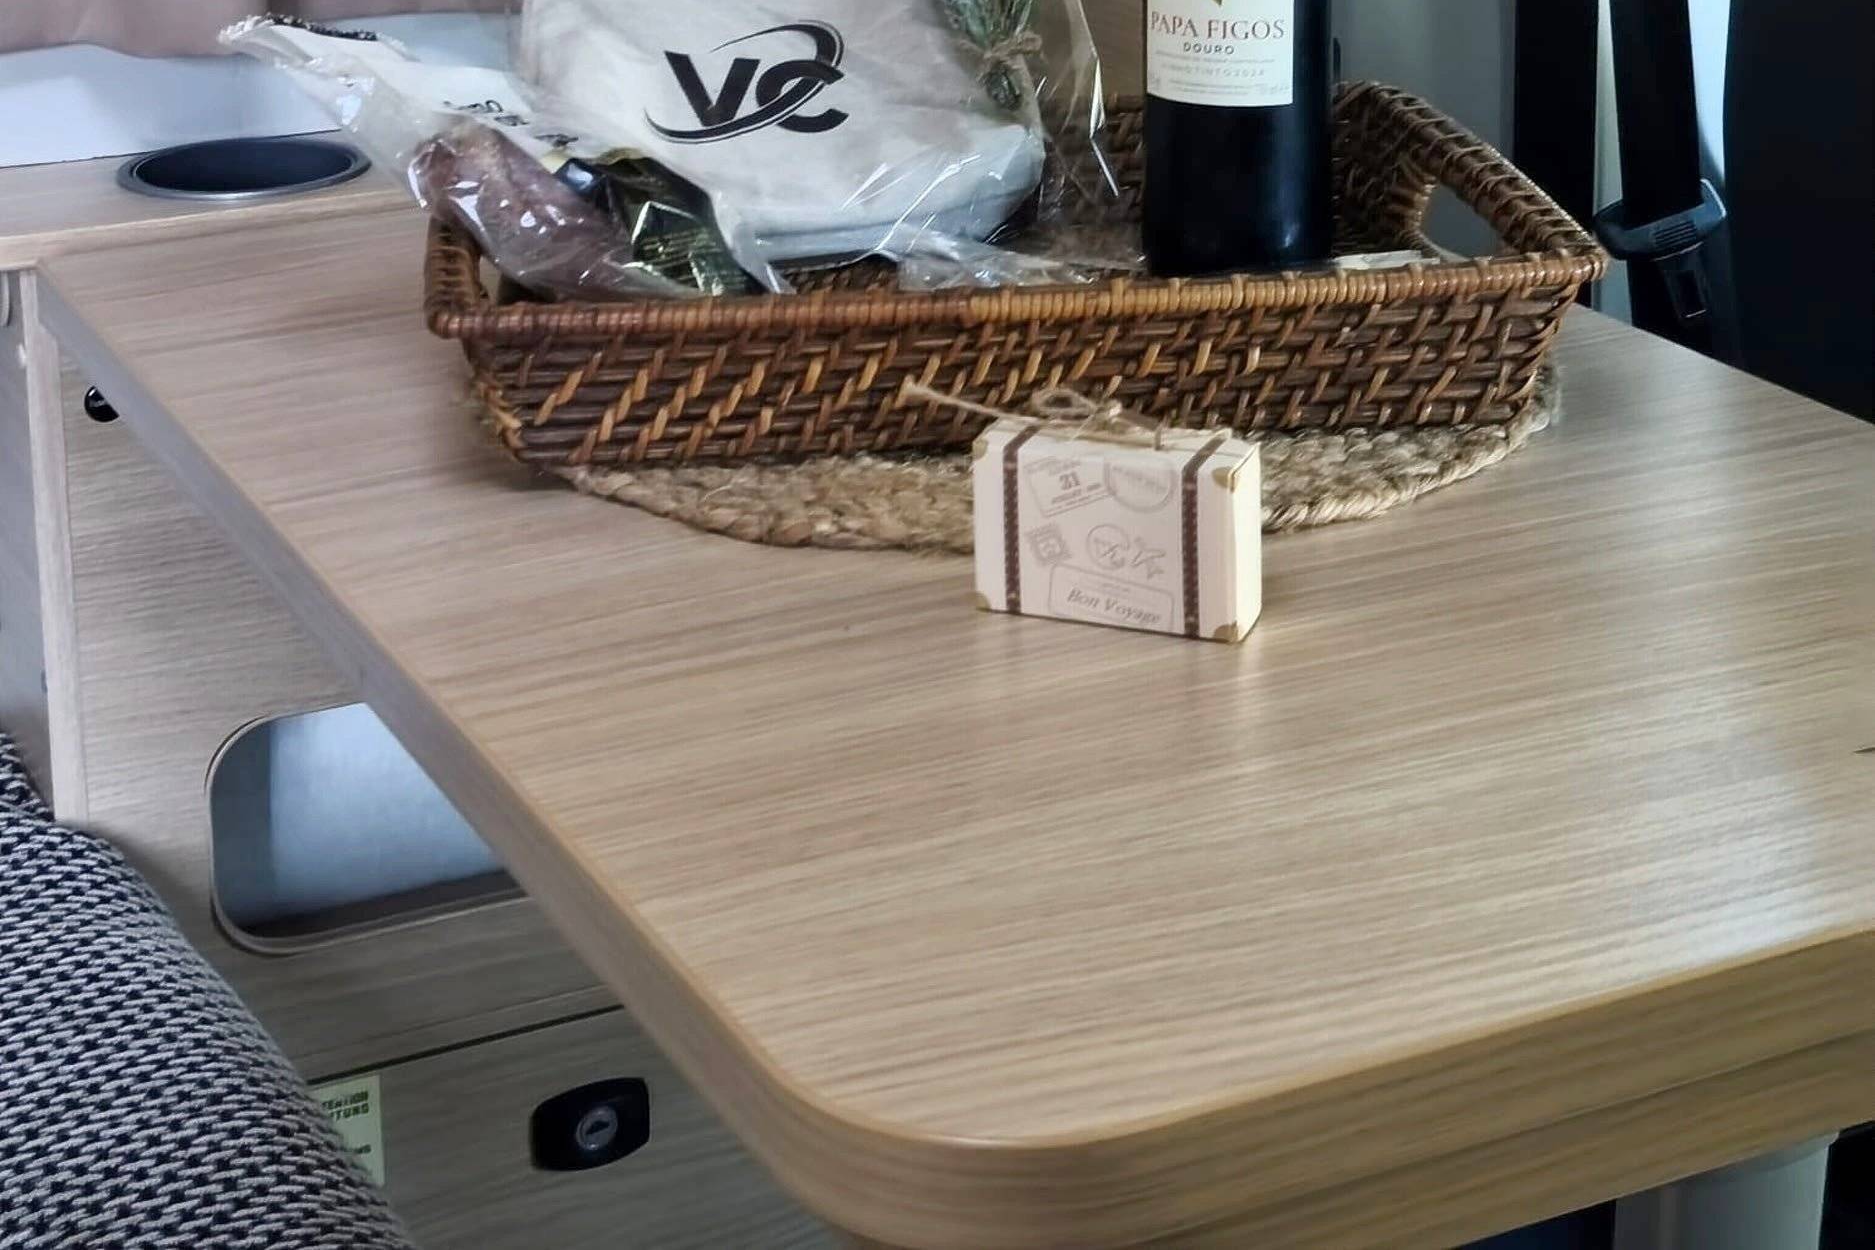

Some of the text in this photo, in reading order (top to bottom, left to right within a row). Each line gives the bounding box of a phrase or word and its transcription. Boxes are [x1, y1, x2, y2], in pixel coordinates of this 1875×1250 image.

[1151, 10, 1286, 41] PAPA FIGOS
[1183, 42, 1235, 55] DOURO
[1067, 586, 1100, 608] Bon
[1104, 597, 1162, 625] Voyage
